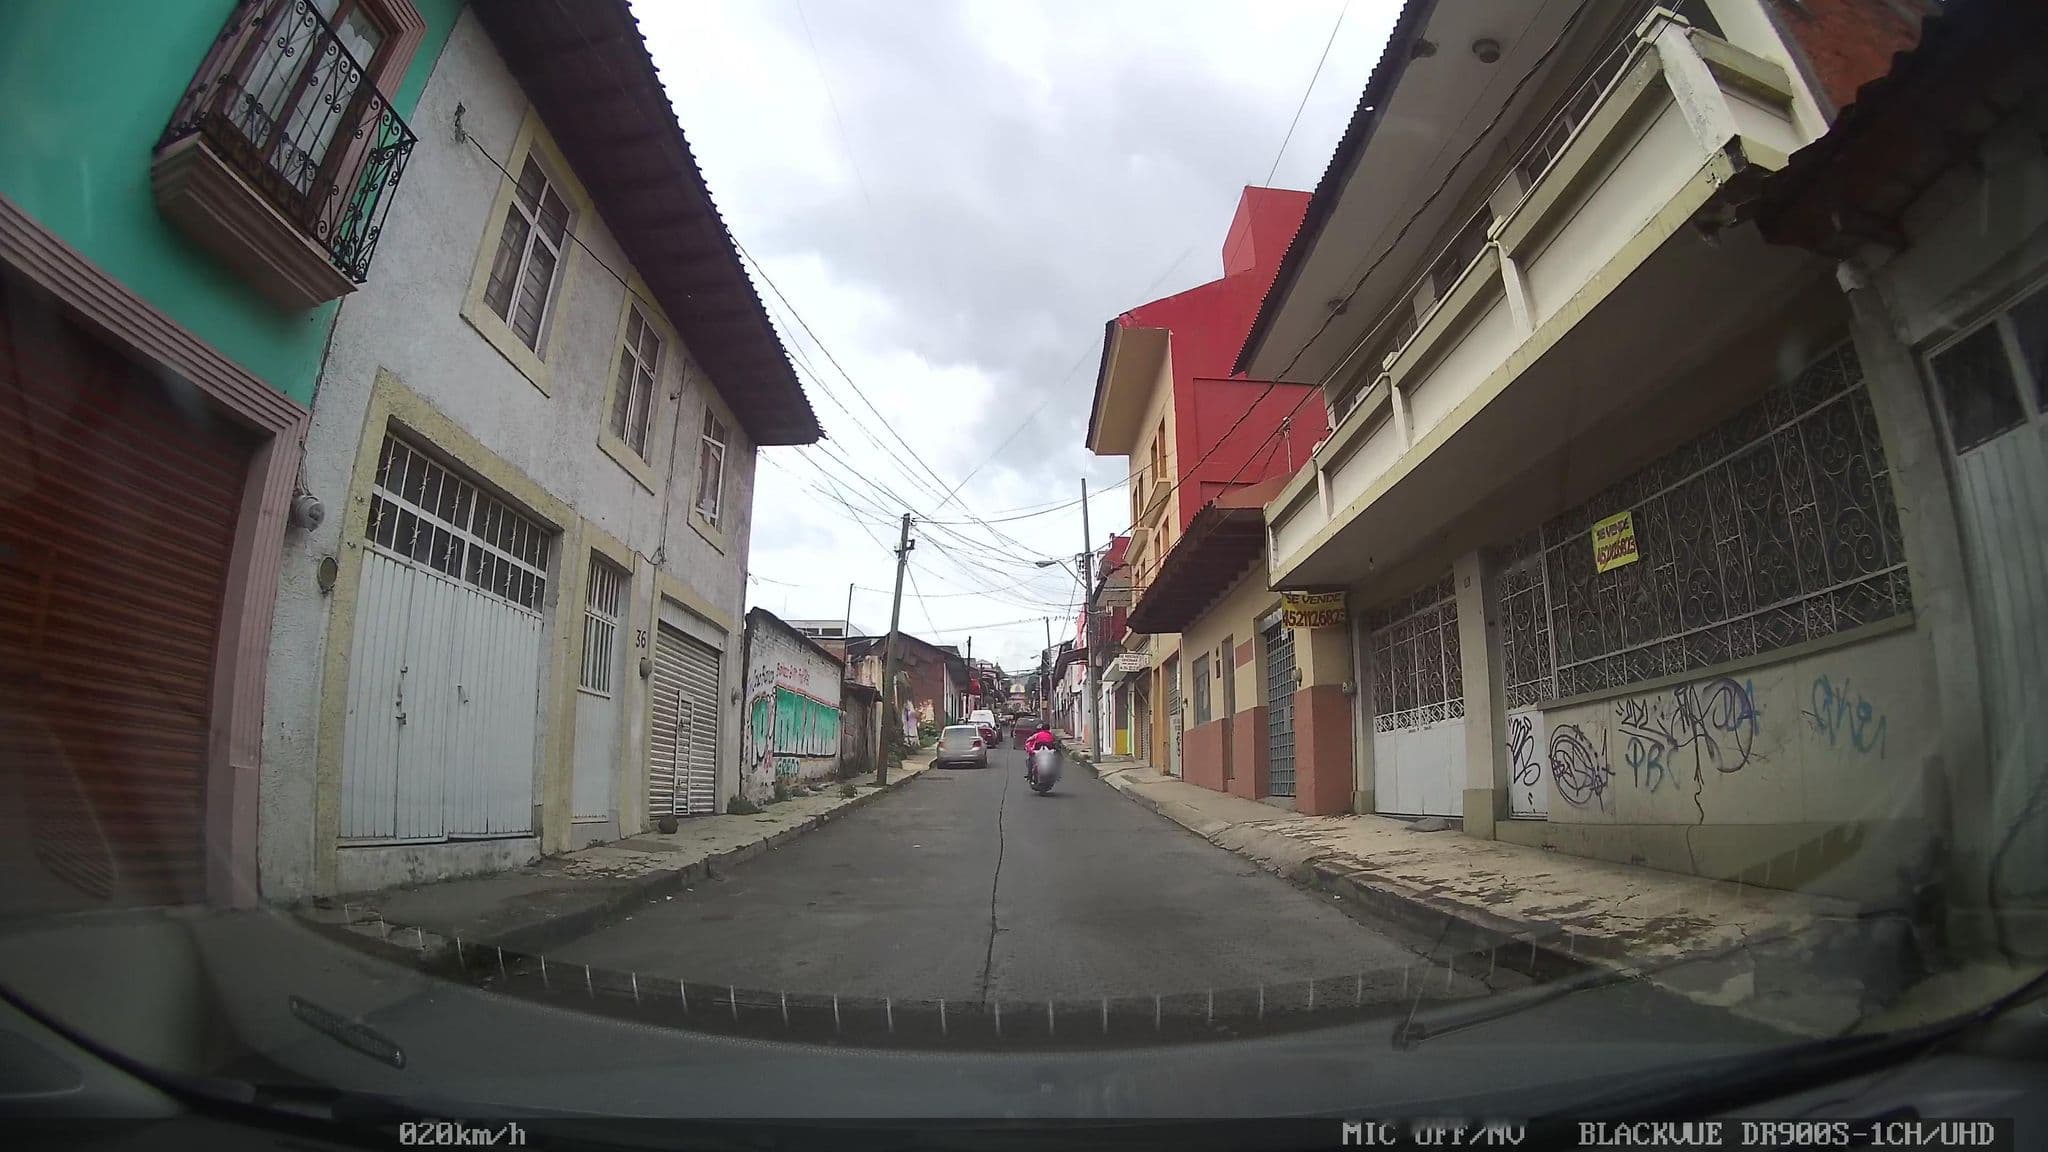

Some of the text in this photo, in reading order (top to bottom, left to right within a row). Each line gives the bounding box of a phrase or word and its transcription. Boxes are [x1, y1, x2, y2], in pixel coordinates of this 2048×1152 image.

[1286, 593, 1341, 605] SE VENDE
[635, 629, 647, 648] 36
